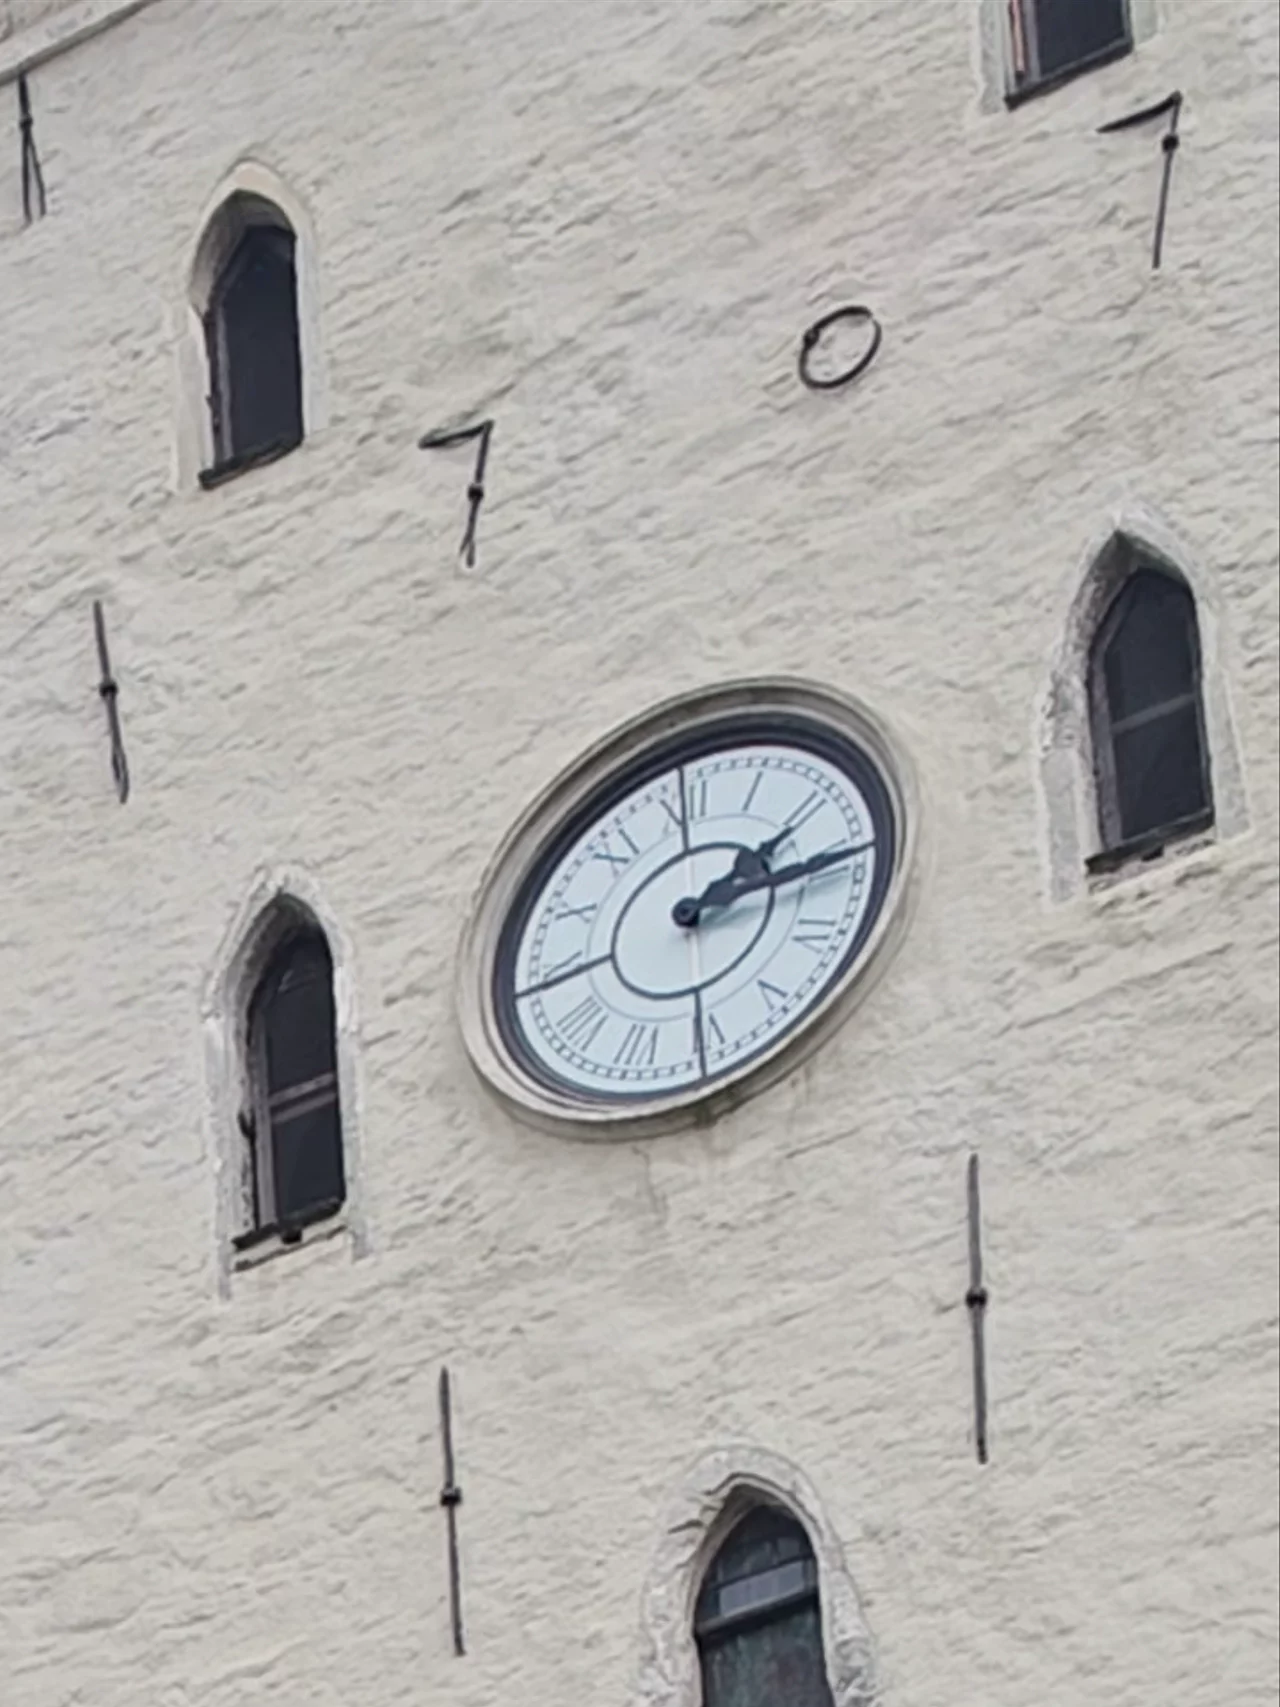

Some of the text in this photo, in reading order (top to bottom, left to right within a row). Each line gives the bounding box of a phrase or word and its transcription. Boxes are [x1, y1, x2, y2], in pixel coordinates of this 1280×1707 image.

[742, 771, 763, 811] I
[783, 790, 827, 832] II
[594, 828, 639, 881] XI
[806, 838, 851, 882] II
[555, 903, 598, 924] X
[792, 916, 837, 955] IV
[757, 979, 789, 1010] V
[556, 996, 609, 1051] VIII
[613, 1023, 658, 1066] VII
